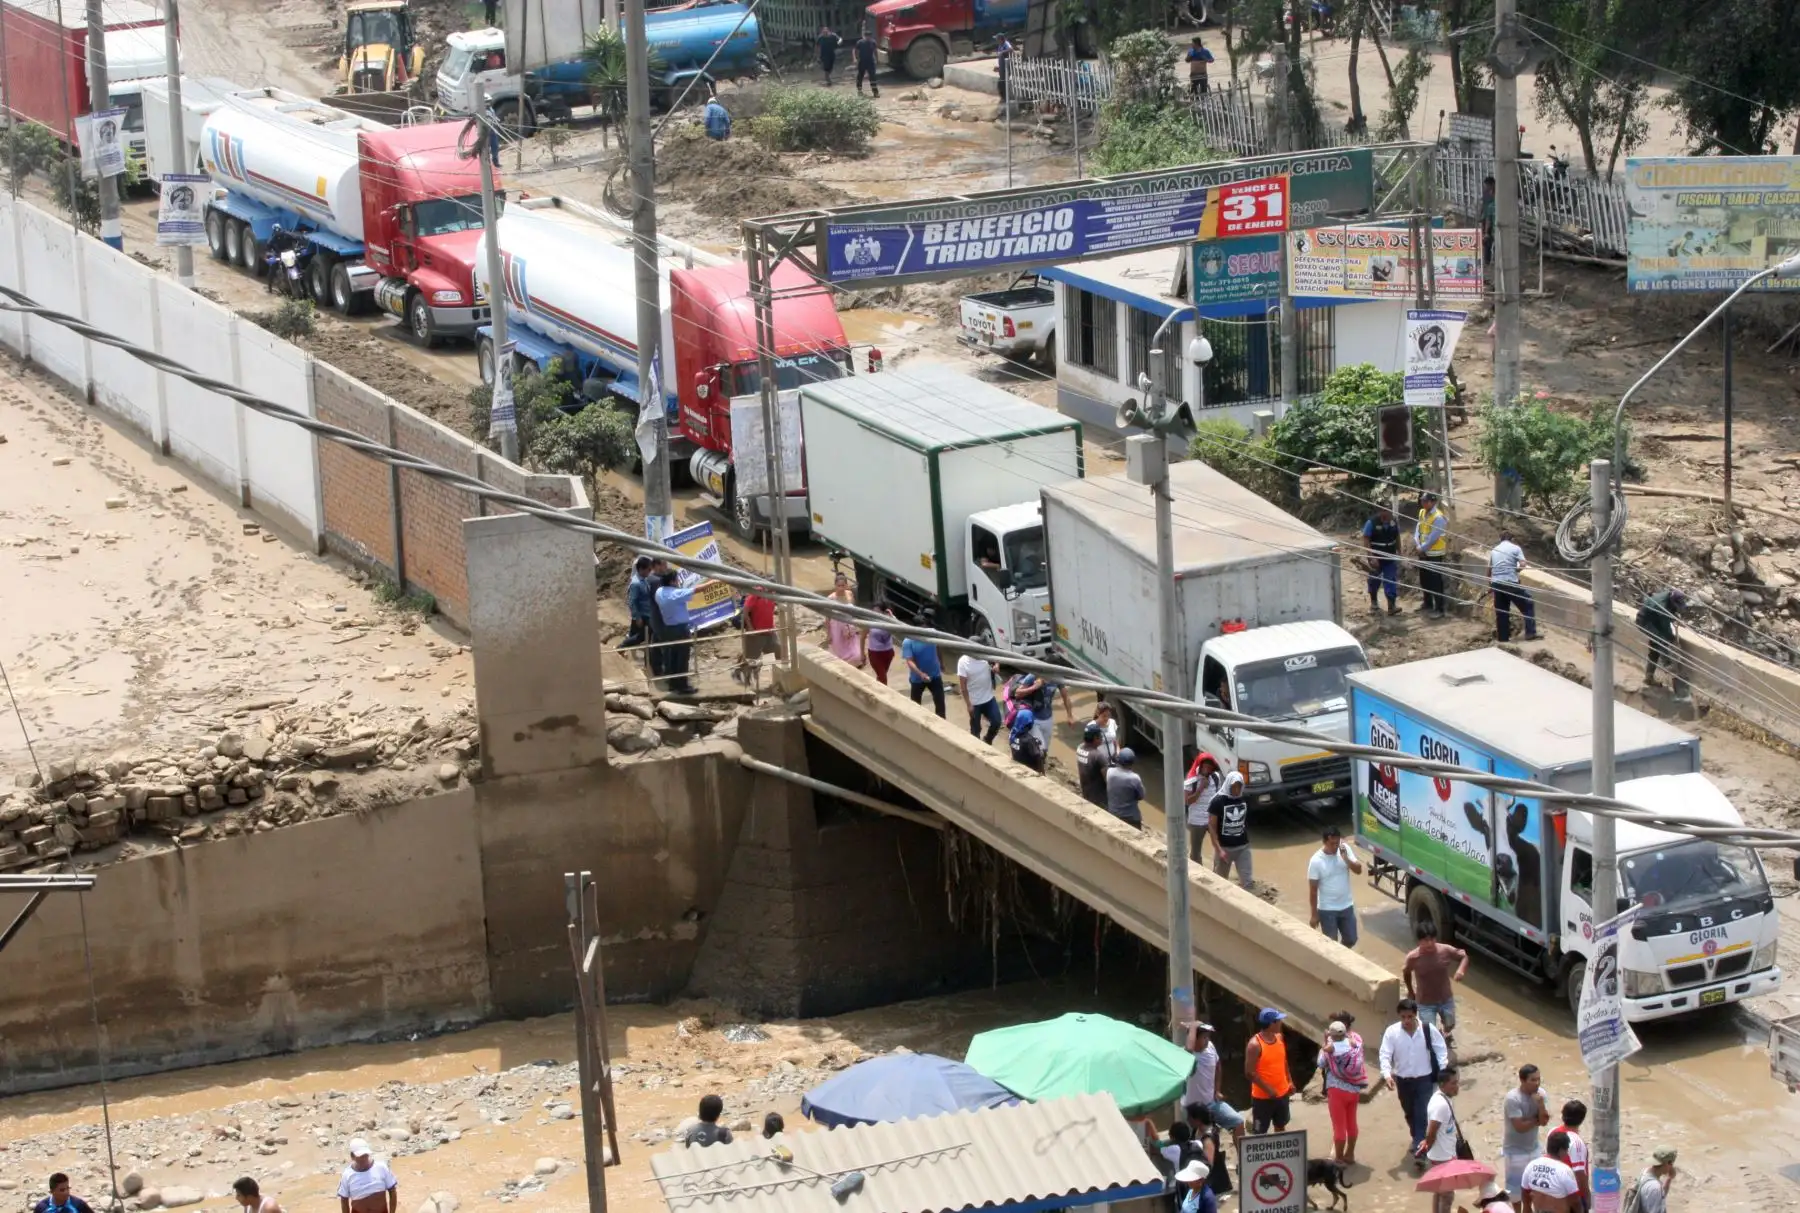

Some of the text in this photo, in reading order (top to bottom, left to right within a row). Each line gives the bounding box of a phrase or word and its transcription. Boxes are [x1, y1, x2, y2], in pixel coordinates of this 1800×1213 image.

[906, 192, 1073, 223] MUNICIPALIDAD
[1077, 183, 1145, 200] SANTA
[1150, 173, 1216, 194] MARIA
[1219, 169, 1246, 184] DE
[1231, 182, 1280, 195] VENCE EL
[1677, 192, 1722, 206] PISCINA
[1223, 192, 1288, 222] 31
[922, 208, 1074, 245] BENEFICIO
[1227, 219, 1284, 232] DE ENERO
[924, 231, 1074, 265] TRIBUTARIO
[1316, 233, 1385, 248] ESCUELA
[1389, 234, 1411, 248] DE
[1294, 256, 1362, 265] DEFENSA PERSONAL
[1635, 280, 1650, 290] AV.
[1652, 279, 1670, 290] LOS
[1671, 279, 1706, 289] CISNES
[968, 317, 996, 331] TOYOTA
[704, 588, 729, 601] OBRAS
[1419, 734, 1460, 765] GLORIA
[1373, 780, 1398, 809] LECHE
[1402, 806, 1422, 829] Pura
[1425, 820, 1449, 842] Leche
[1450, 834, 1460, 852] de
[1462, 840, 1486, 865] Vaca
[1689, 927, 1728, 945] GLORIA
[1246, 1138, 1299, 1153] PROHIBIDO
[1246, 1148, 1300, 1163] CIRCULACION
